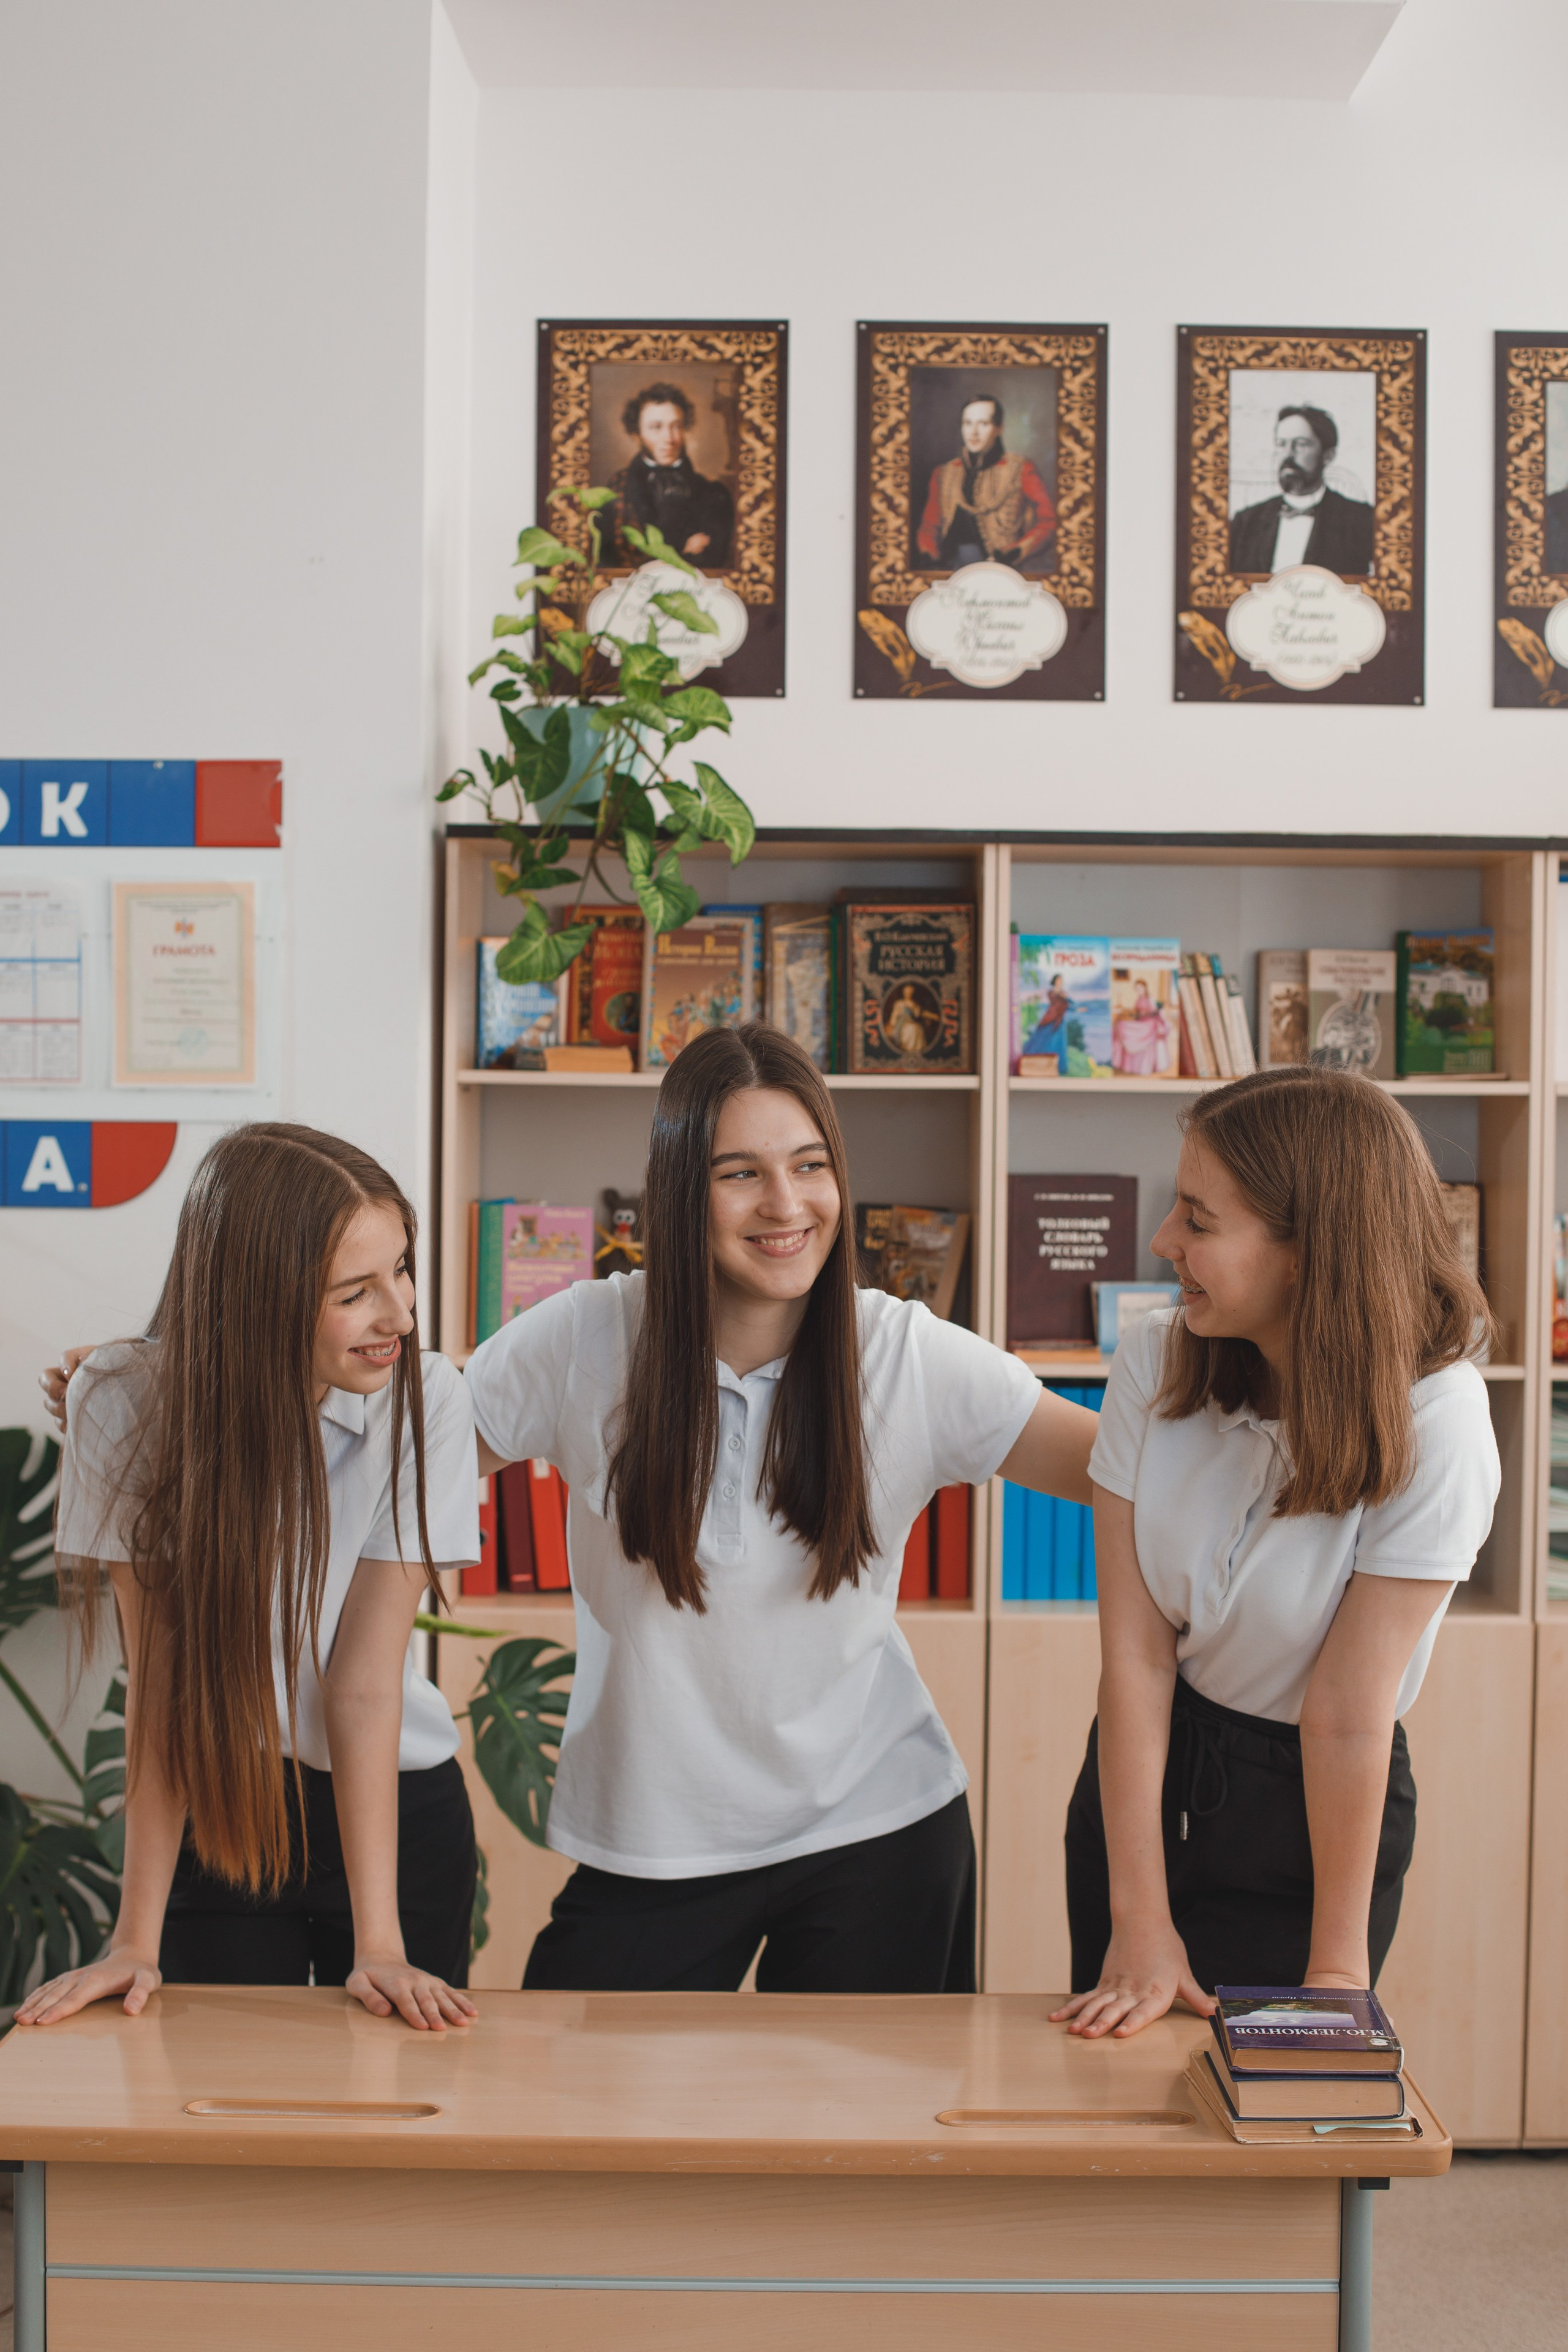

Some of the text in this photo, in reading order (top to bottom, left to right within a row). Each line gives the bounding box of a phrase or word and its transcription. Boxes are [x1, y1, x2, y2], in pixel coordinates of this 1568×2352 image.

[0, 782, 89, 837] К
[880, 944, 944, 957] РУССКАЯ
[878, 957, 946, 971] ИСТОРИЯ
[1054, 952, 1096, 968] ГРОЗА
[1037, 1216, 1110, 1231] ТОЛКОВЫЙ
[1043, 1231, 1104, 1244] СЛОВАРЬ
[1038, 1244, 1108, 1257] РУССКОГО
[1050, 1257, 1096, 1271] ЯЗЫКА
